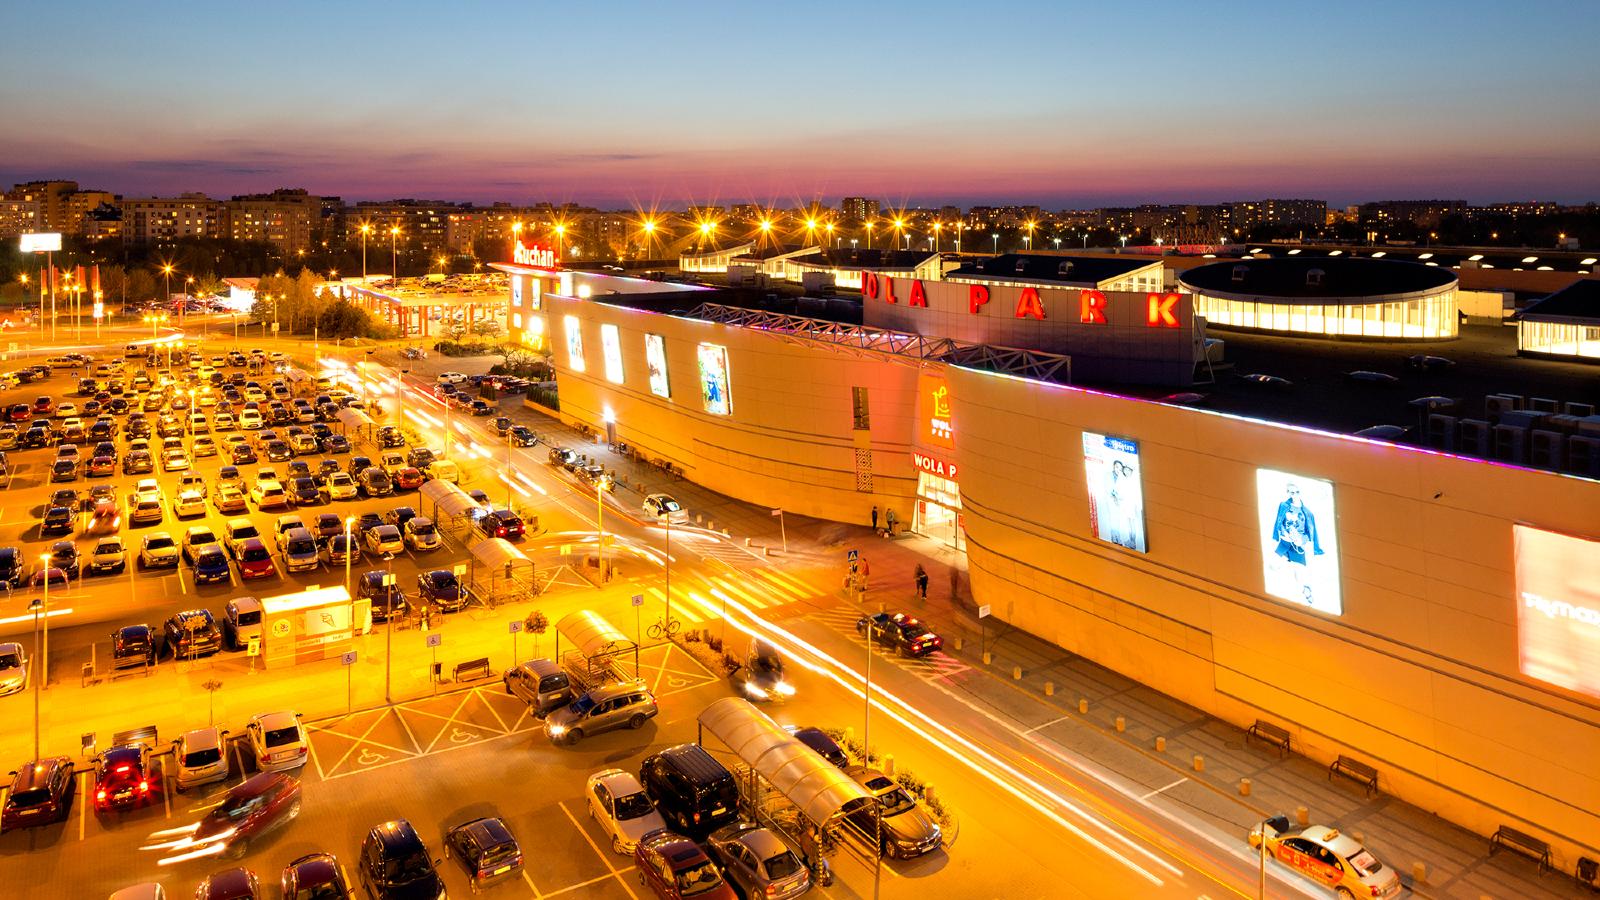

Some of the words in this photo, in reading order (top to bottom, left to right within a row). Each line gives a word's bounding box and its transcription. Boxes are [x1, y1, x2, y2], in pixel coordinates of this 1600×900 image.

[514, 240, 554, 268] Auchan
[969, 284, 1182, 327] PARK
[914, 453, 944, 474] WOLA
